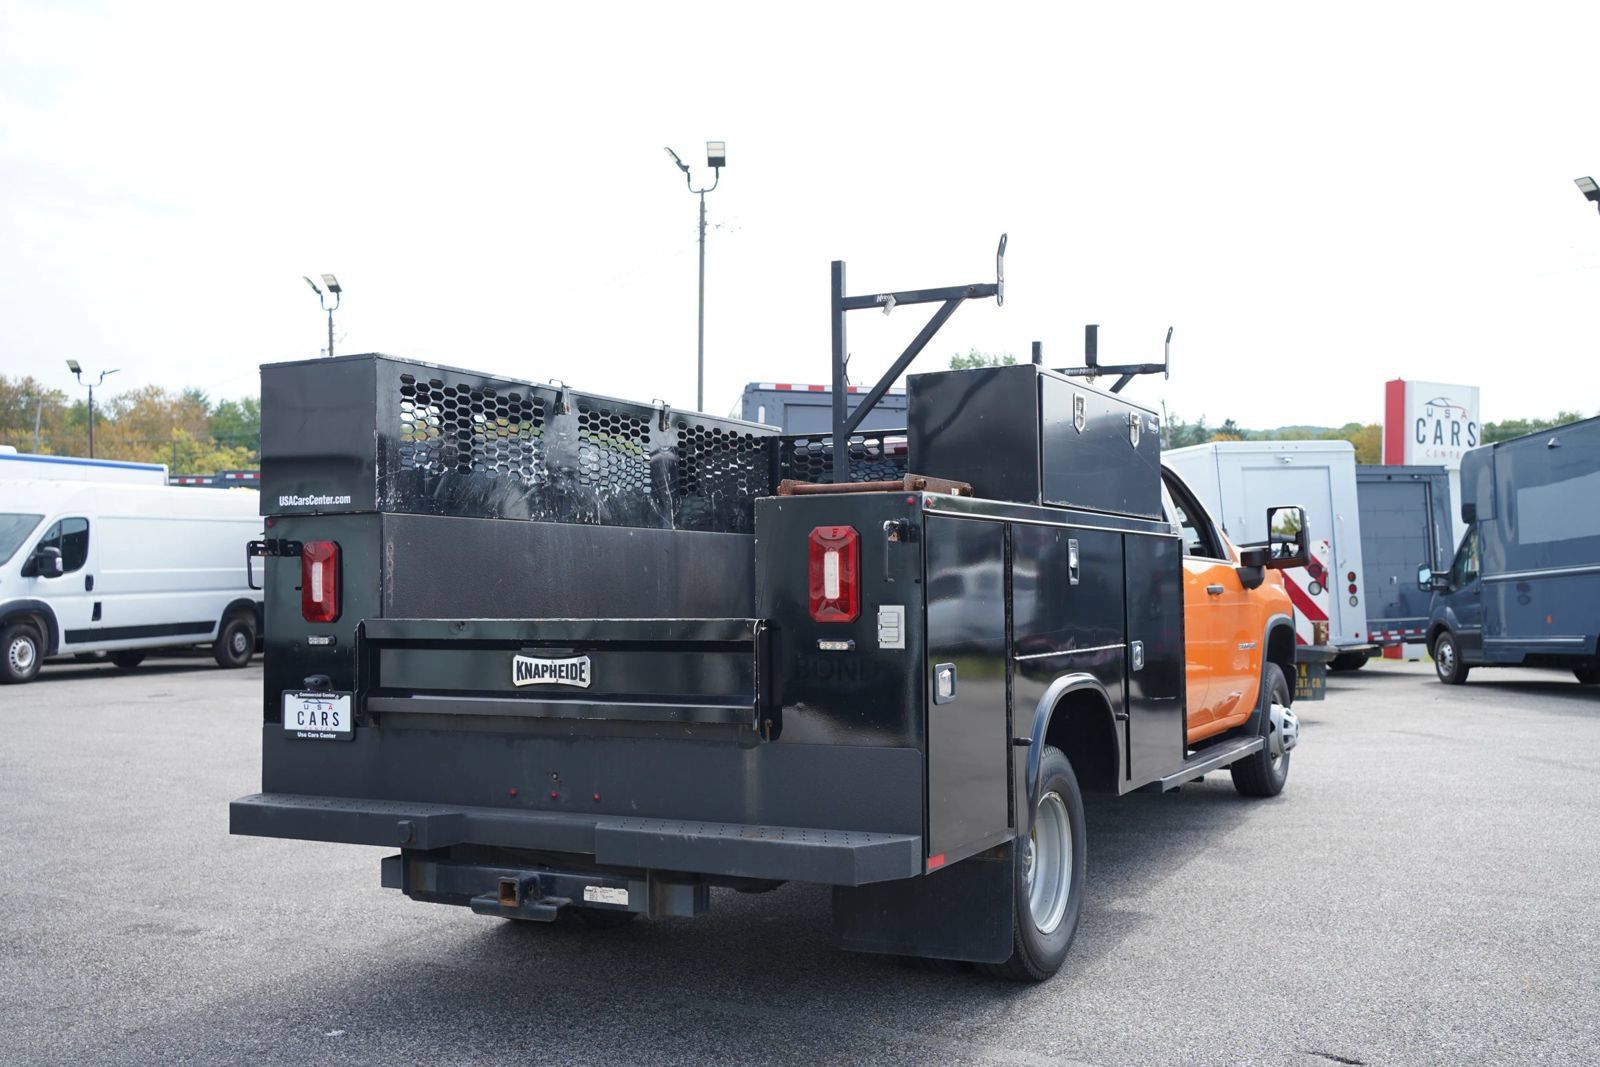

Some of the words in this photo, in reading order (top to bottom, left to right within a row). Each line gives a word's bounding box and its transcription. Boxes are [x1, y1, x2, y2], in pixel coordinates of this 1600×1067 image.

[1426, 407, 1467, 419] USA
[1416, 417, 1477, 447] CARS
[1425, 449, 1461, 460] CENTE
[279, 494, 351, 506] USACarsCenter.com
[516, 660, 586, 682] KNAPHEIDE
[297, 711, 339, 726] CARS
